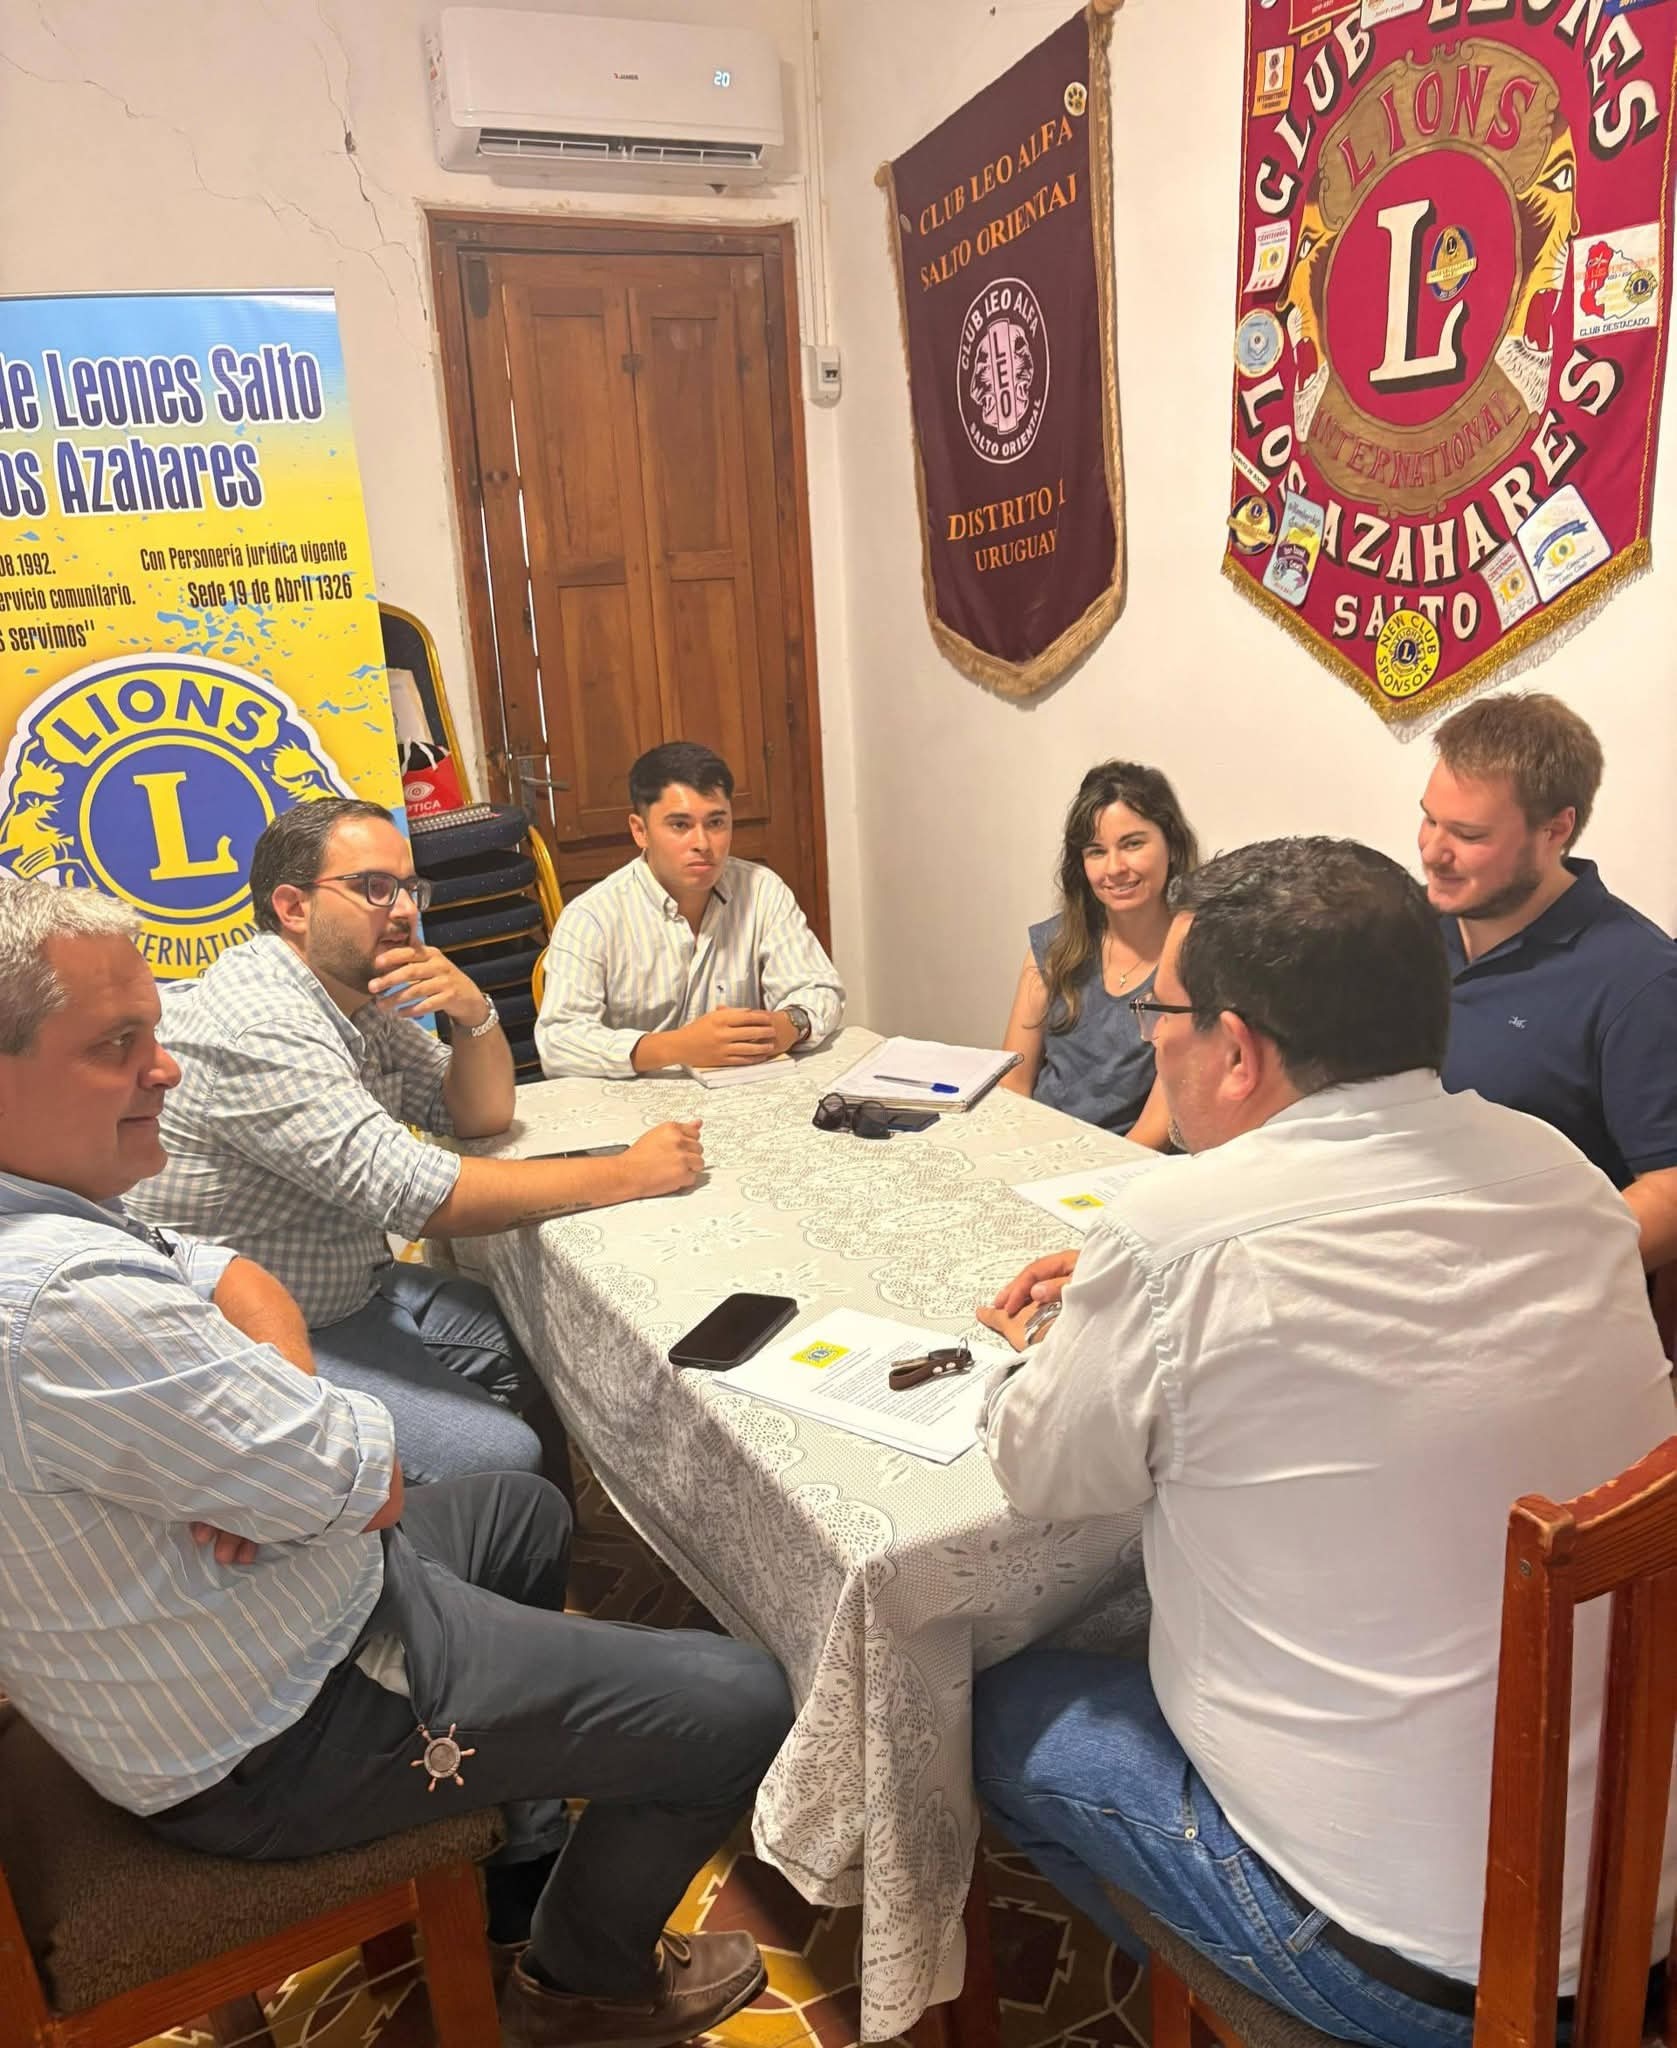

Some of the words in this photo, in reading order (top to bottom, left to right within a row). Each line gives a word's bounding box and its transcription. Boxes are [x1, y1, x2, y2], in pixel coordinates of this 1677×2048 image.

[713, 70, 731, 88] 20
[1254, 10, 1371, 213] CLUB
[1338, 63, 1539, 188] LIONS
[918, 185, 964, 236] CLUB
[970, 155, 1012, 202] LEO
[1017, 114, 1073, 173] ALFA
[920, 240, 971, 291] SALTO
[1369, 199, 1466, 386] L
[962, 310, 983, 371] CLUB
[985, 288, 1011, 318] LEO
[1013, 291, 1038, 338] ALFA
[1580, 326, 1600, 337] CLUB
[1603, 316, 1650, 332] DESTACADO
[45, 352, 204, 428] Leones
[210, 345, 323, 423] Salto
[993, 331, 1012, 418] LEO
[56, 437, 263, 514] Azahares
[1310, 390, 1521, 489] INTERNATIONAL
[1321, 347, 1616, 583] AZAHARES
[947, 487, 1053, 541] DISTRITO
[975, 528, 1056, 572] URUGUAY
[140, 548, 166, 571] Con
[301, 539, 348, 565] vigente
[188, 580, 227, 608] Sede
[229, 579, 248, 606] 19
[251, 578, 271, 605] de
[275, 575, 314, 603] Abril
[316, 573, 353, 601] 1326
[1380, 614, 1406, 648] NEW
[1411, 615, 1436, 654] CLUB
[1378, 656, 1431, 692] SPONSOR
[52, 678, 268, 756] LIONS
[133, 771, 239, 881] L
